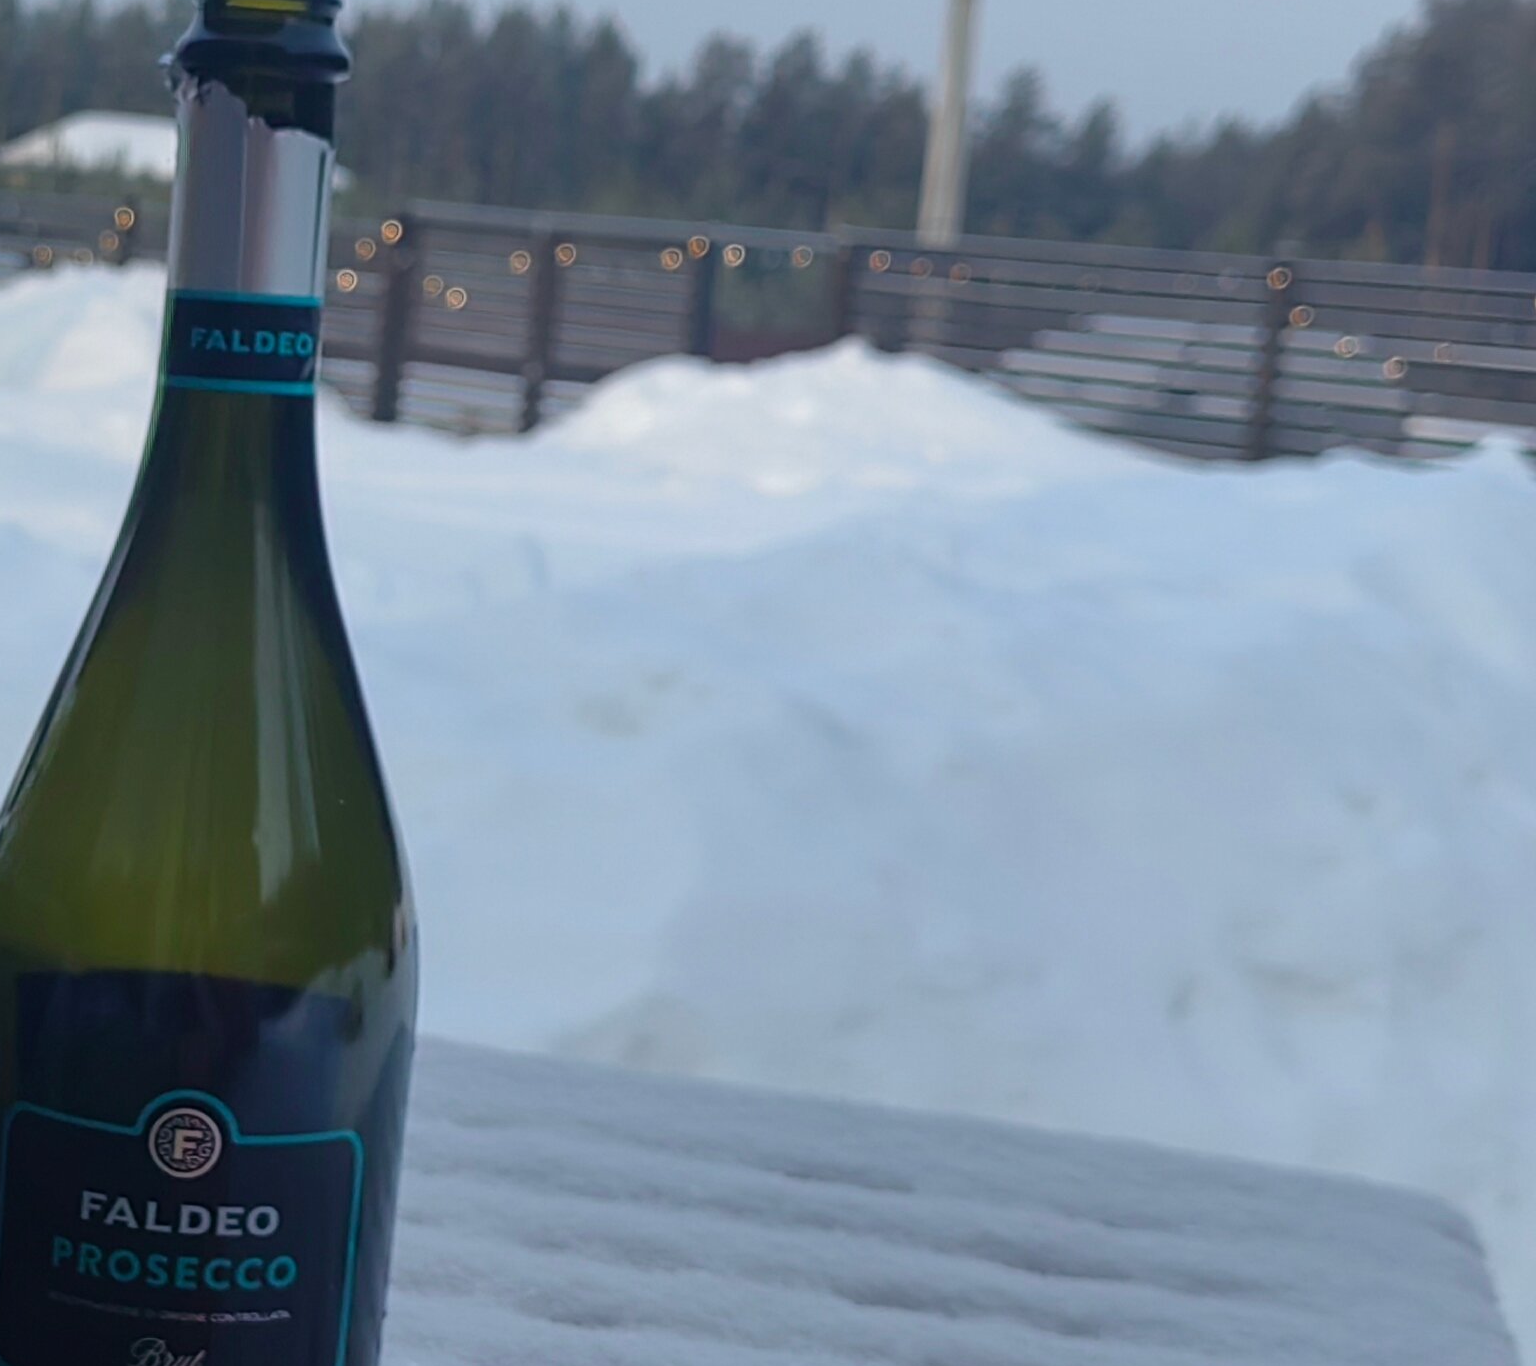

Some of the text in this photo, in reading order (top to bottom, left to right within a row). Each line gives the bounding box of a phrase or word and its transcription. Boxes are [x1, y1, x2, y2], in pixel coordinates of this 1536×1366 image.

[191, 327, 314, 355] FALDEO
[172, 1128, 204, 1160] F
[80, 1190, 280, 1236] FALDEO
[52, 1237, 297, 1290] PROSECCO
